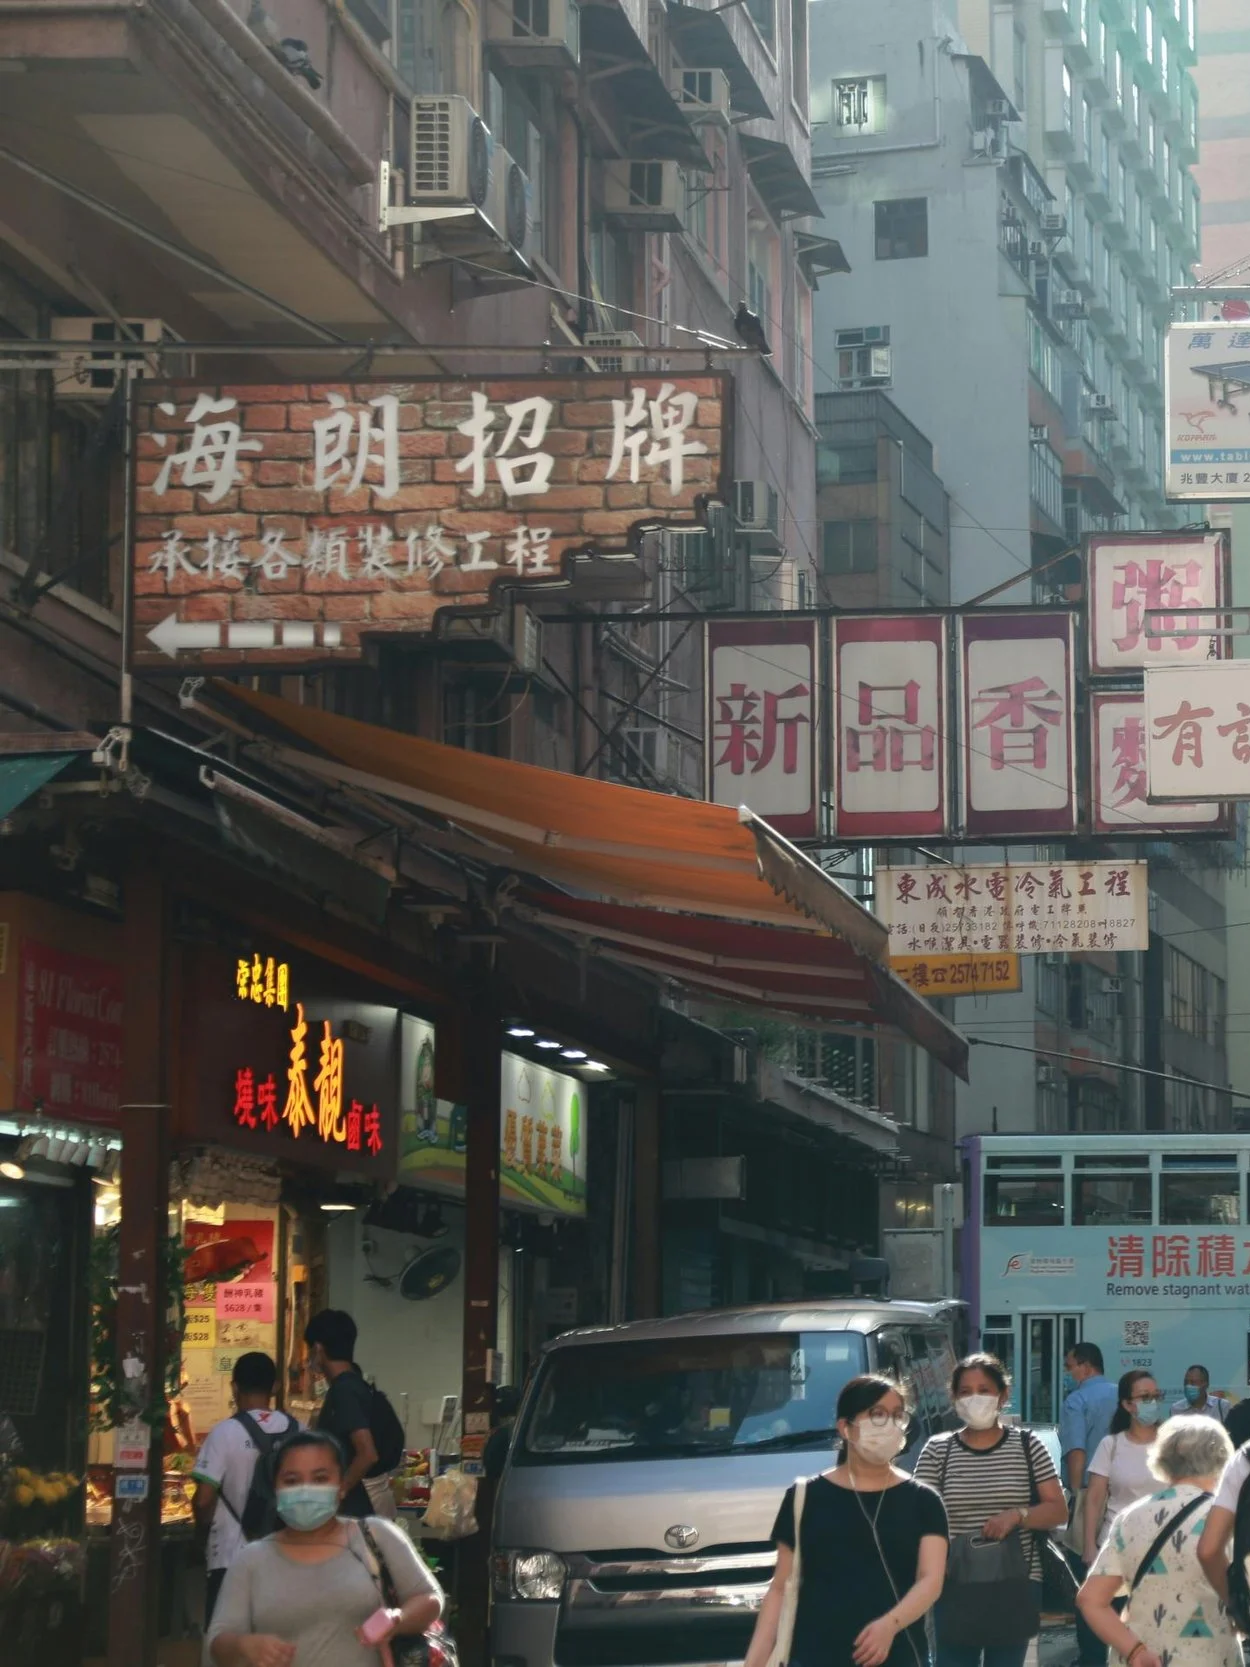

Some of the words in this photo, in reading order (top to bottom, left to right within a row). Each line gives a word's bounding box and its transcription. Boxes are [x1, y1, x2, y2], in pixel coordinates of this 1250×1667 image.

[152, 381, 708, 504] 海朗招牌
[147, 525, 555, 581] 承接各類裝修工程
[896, 869, 1132, 904] 東成水電冷氣工程
[234, 1067, 279, 1131] 燒味
[1106, 1283, 1159, 1296] Remove
[1163, 1283, 1222, 1300] stagnant
[1132, 1358, 1152, 1367] 1823
